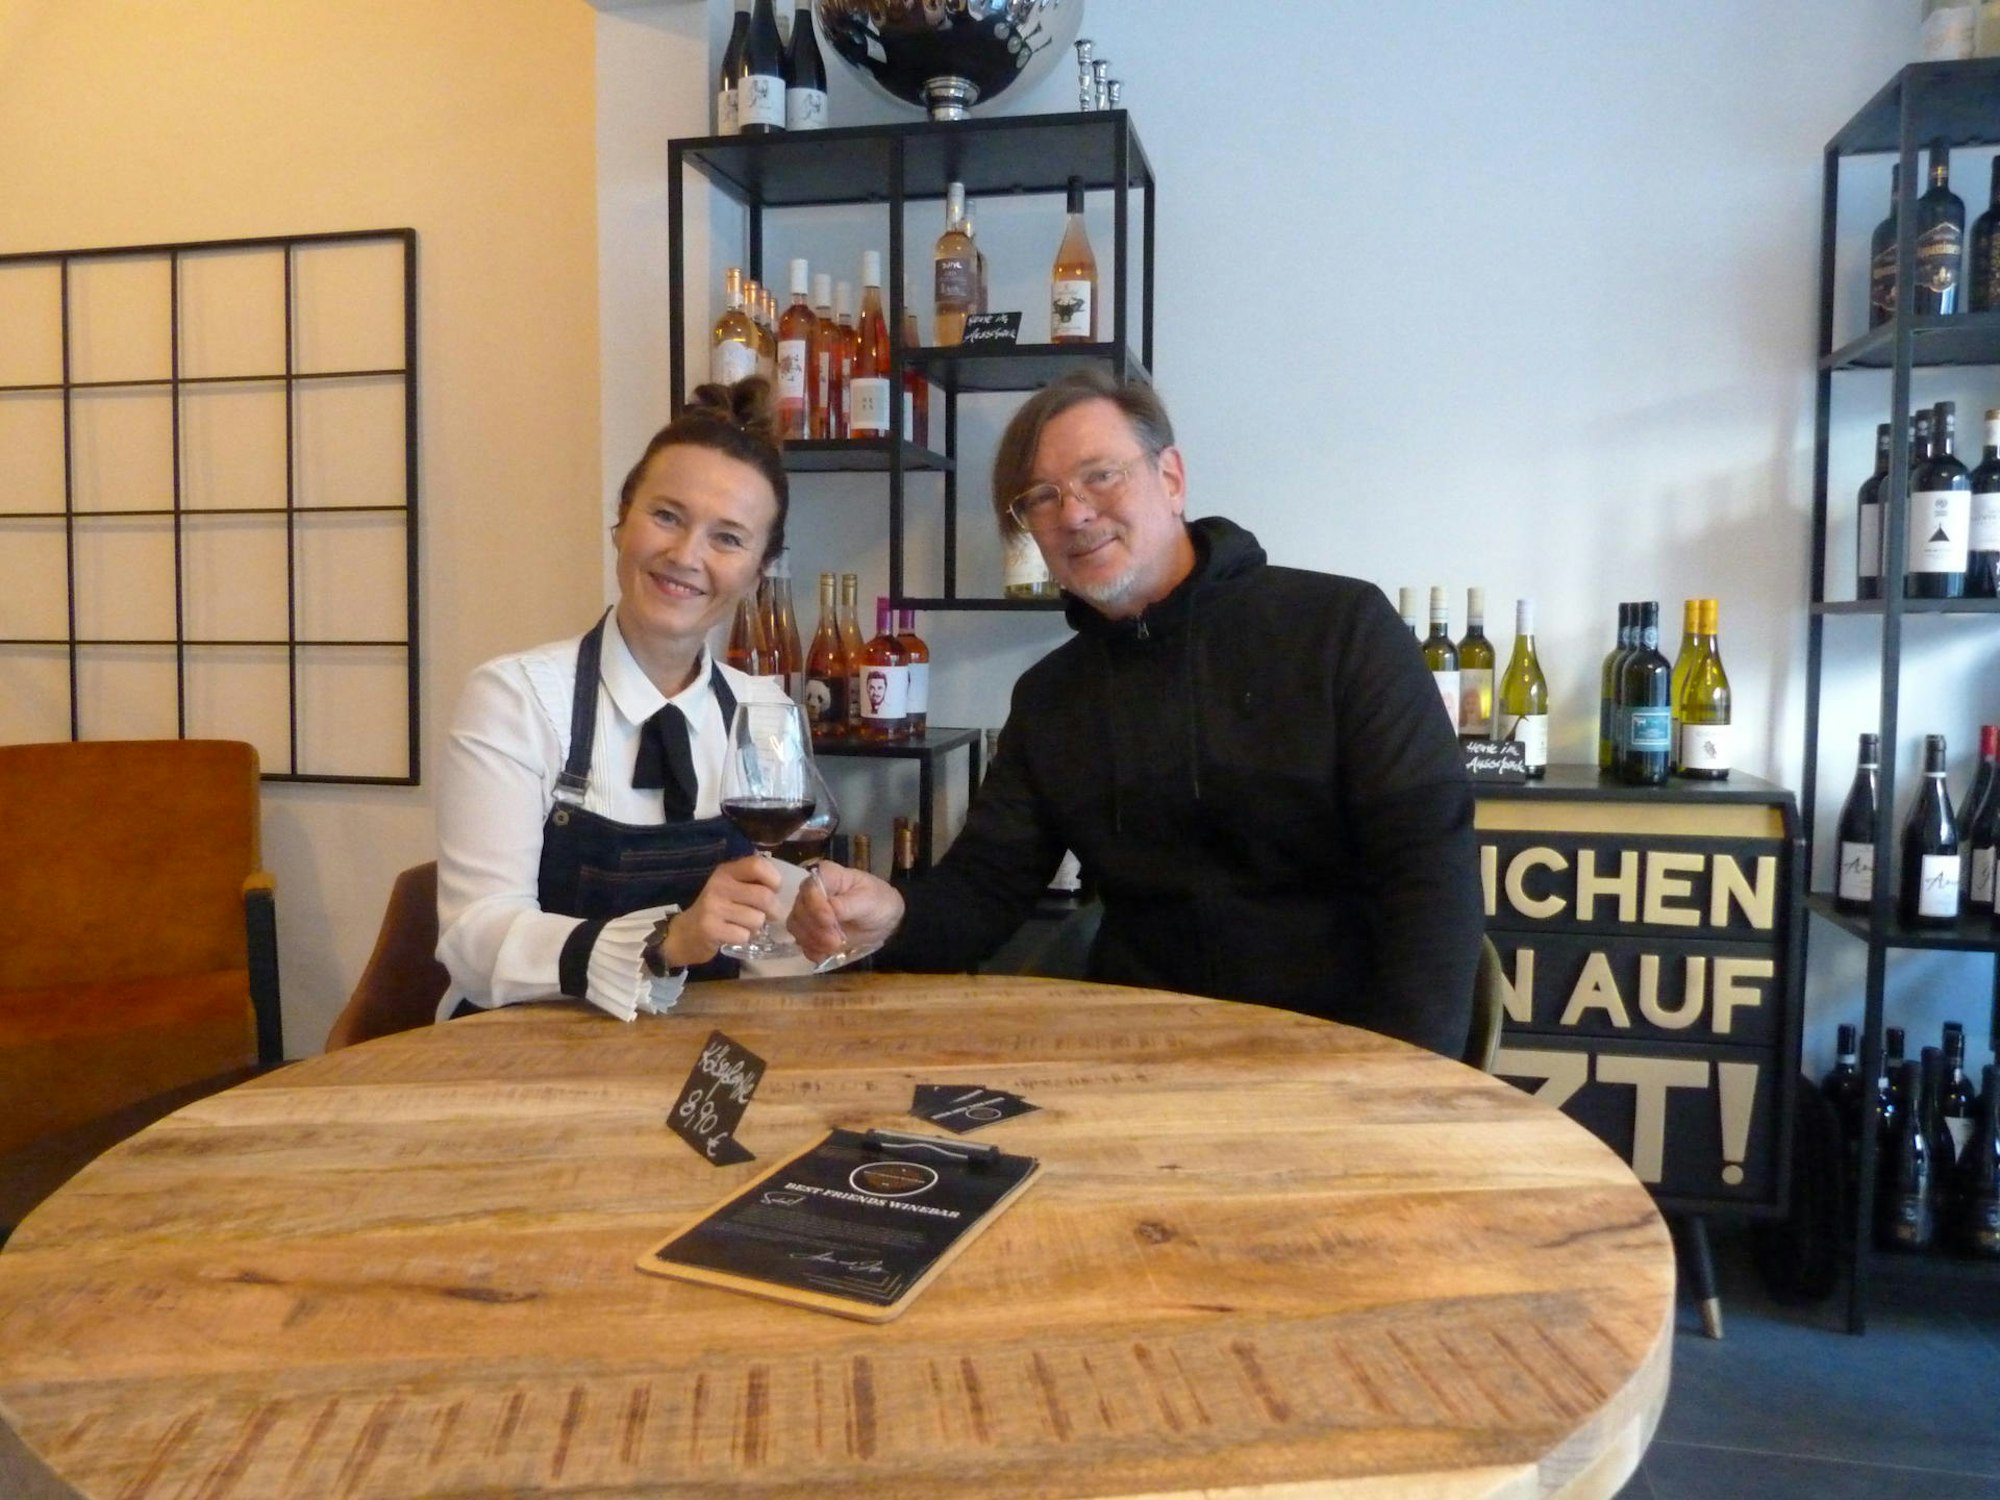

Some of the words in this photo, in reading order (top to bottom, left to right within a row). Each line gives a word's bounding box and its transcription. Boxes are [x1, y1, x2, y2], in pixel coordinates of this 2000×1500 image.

[1480, 845, 1777, 929] ICHEN
[1559, 952, 1774, 1034] AUF
[707, 1132, 729, 1157] €
[784, 1182, 824, 1194] BEST
[823, 1189, 888, 1207] FRIENDS
[889, 1200, 960, 1218] WINEBAR
